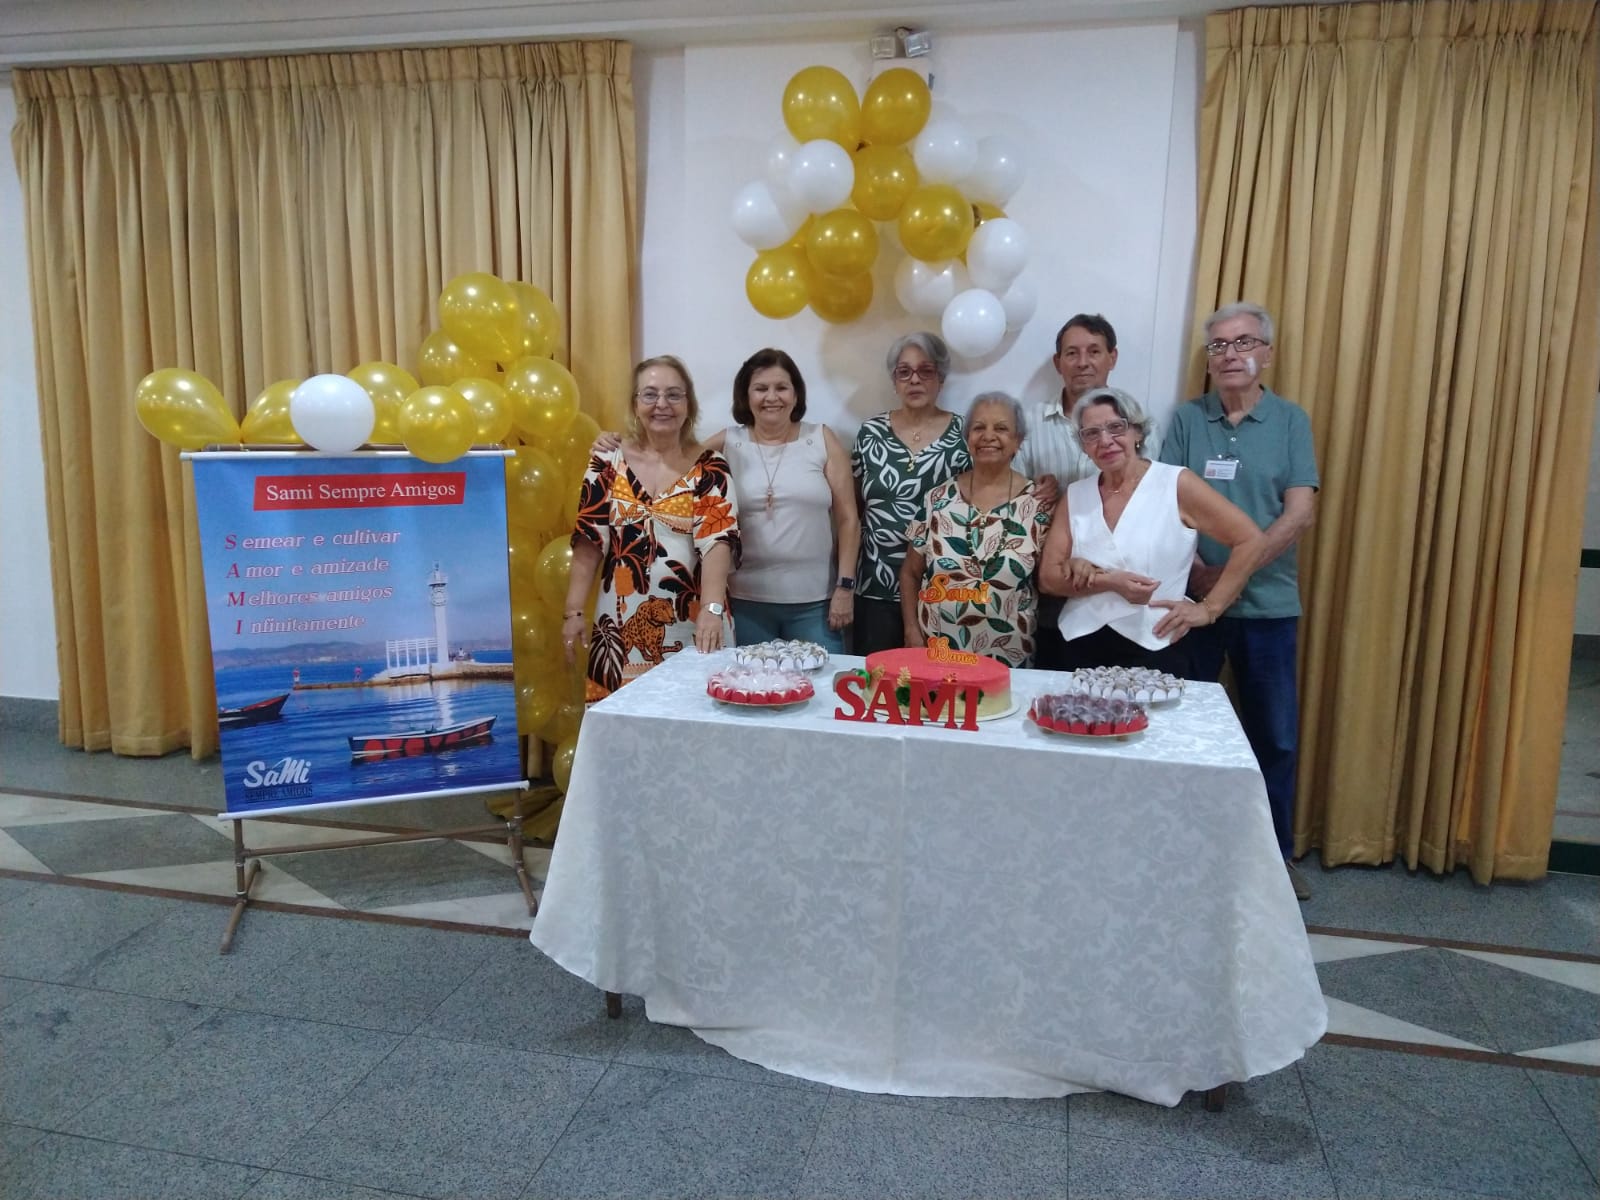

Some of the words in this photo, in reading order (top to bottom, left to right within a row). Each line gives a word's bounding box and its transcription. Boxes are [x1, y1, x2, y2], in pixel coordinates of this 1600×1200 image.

[266, 485, 313, 501] Sami
[319, 484, 386, 502] Sempre
[391, 482, 456, 499] Amigos
[312, 534, 325, 546] e
[332, 530, 401, 545] cultivar
[291, 564, 303, 576] e
[311, 558, 389, 575] amizade
[326, 586, 393, 604] amigos
[919, 574, 992, 604] Sami
[834, 675, 979, 731] SAMI
